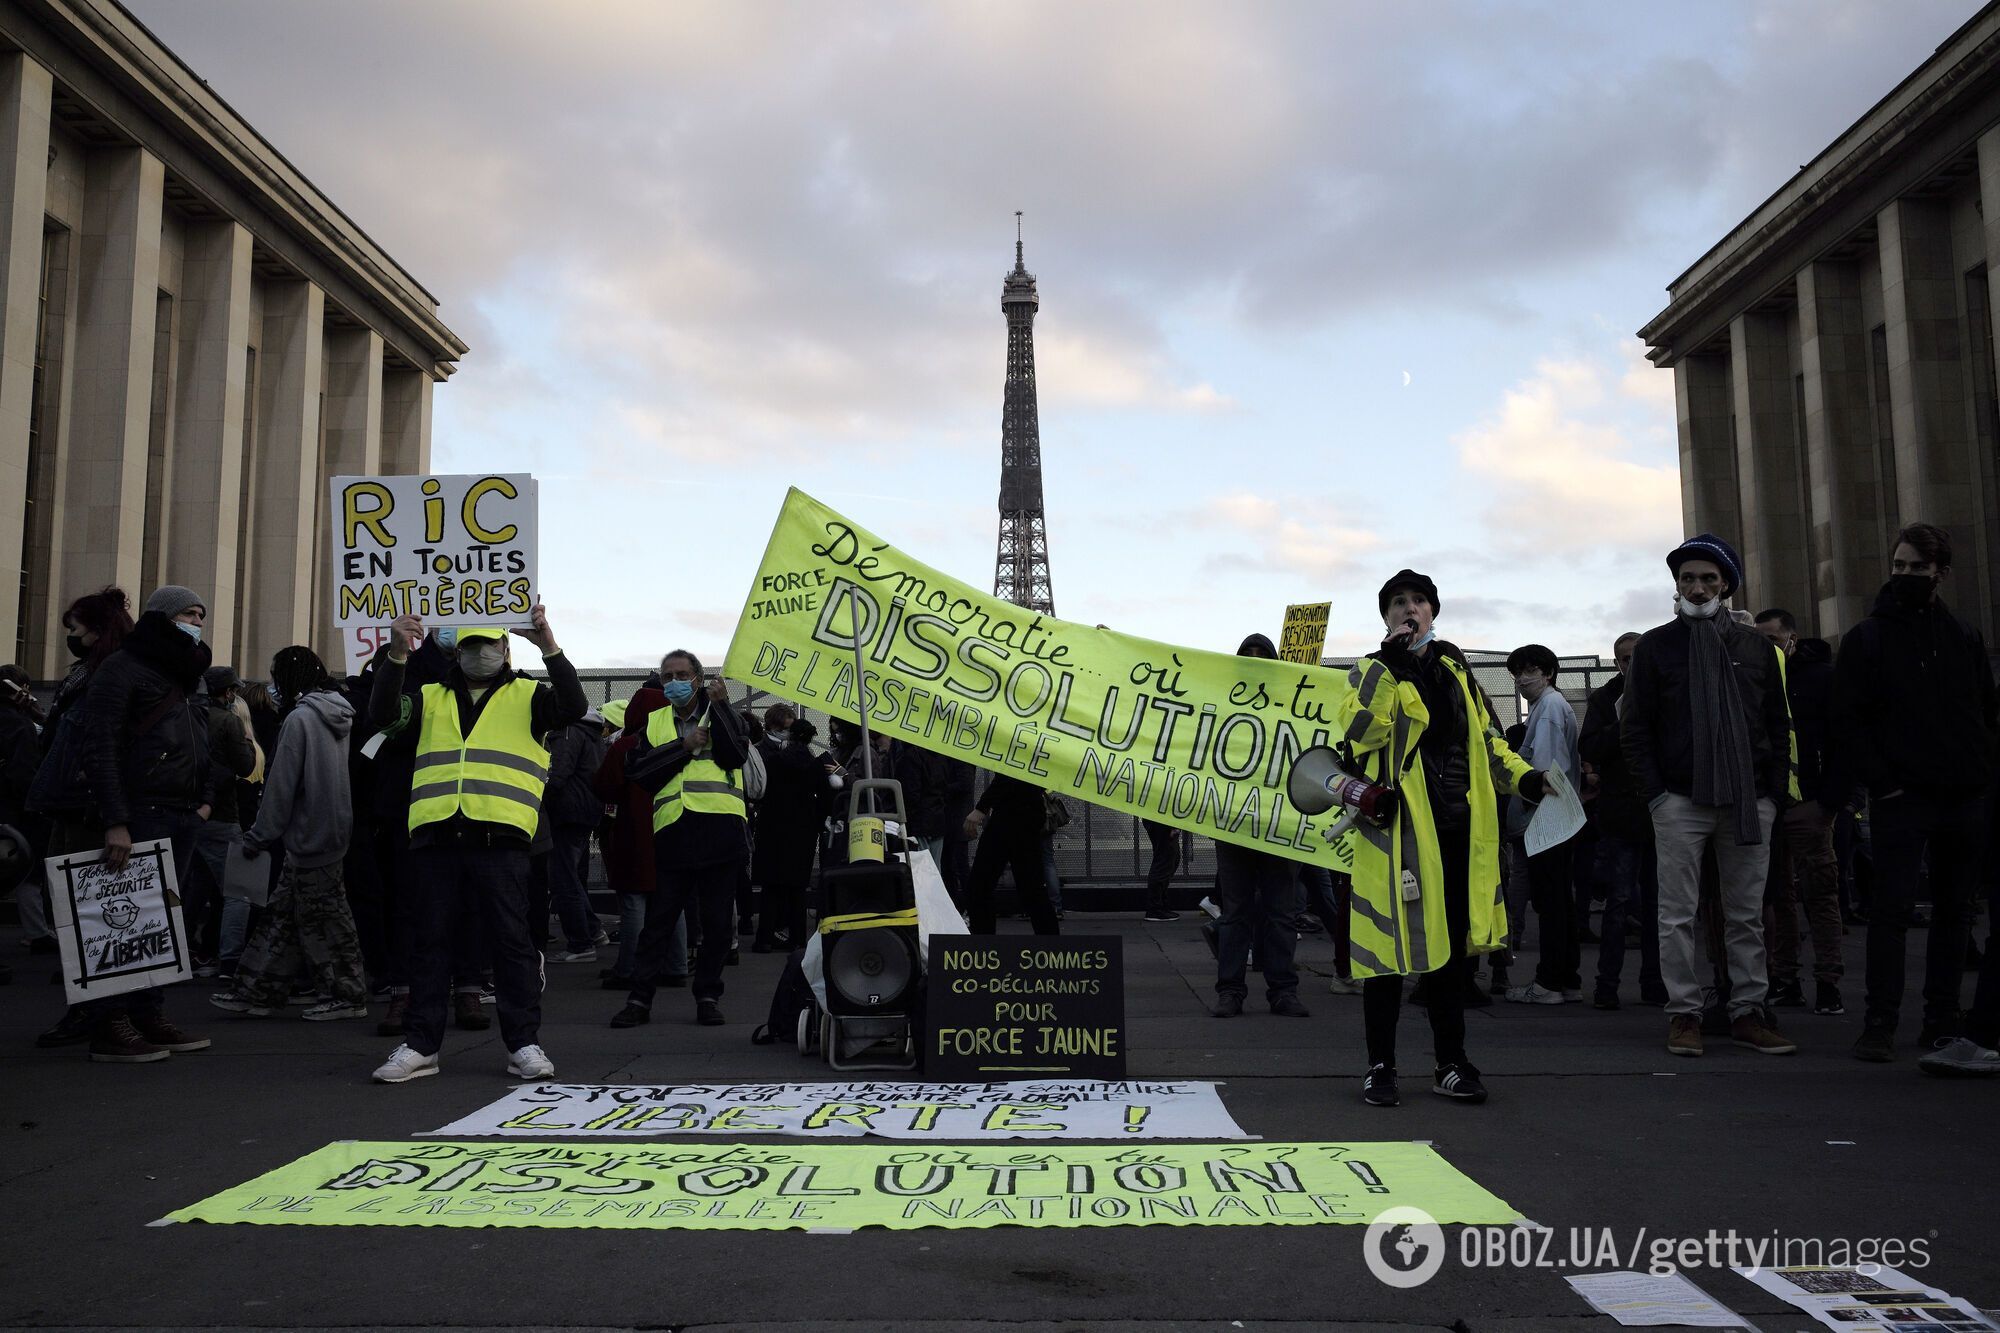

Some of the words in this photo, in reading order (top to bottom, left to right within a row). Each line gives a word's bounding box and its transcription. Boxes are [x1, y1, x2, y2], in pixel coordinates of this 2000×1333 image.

[343, 551, 393, 580] EN
[413, 545, 525, 574] TOUTES
[762, 568, 831, 592] FORCE
[751, 592, 818, 620] JAUNE
[1130, 653, 1188, 697] où
[1229, 675, 1331, 724] es-tu
[751, 640, 798, 686] DE
[797, 651, 1060, 777] L'ASSEMBLÉE
[943, 950, 1000, 970] NOUS
[1019, 949, 1108, 970] SOMMES
[951, 972, 1101, 995] CO-DÉCLARANTS
[994, 1002, 1058, 1021] POUR
[938, 1026, 1025, 1056] FORCE
[1035, 1026, 1118, 1057] JAUNE
[519, 1085, 716, 1103] STOP
[317, 1157, 1307, 1197] DISSOLUTION
[238, 1194, 338, 1213] DE
[902, 1194, 1366, 1221] NATIONALE
